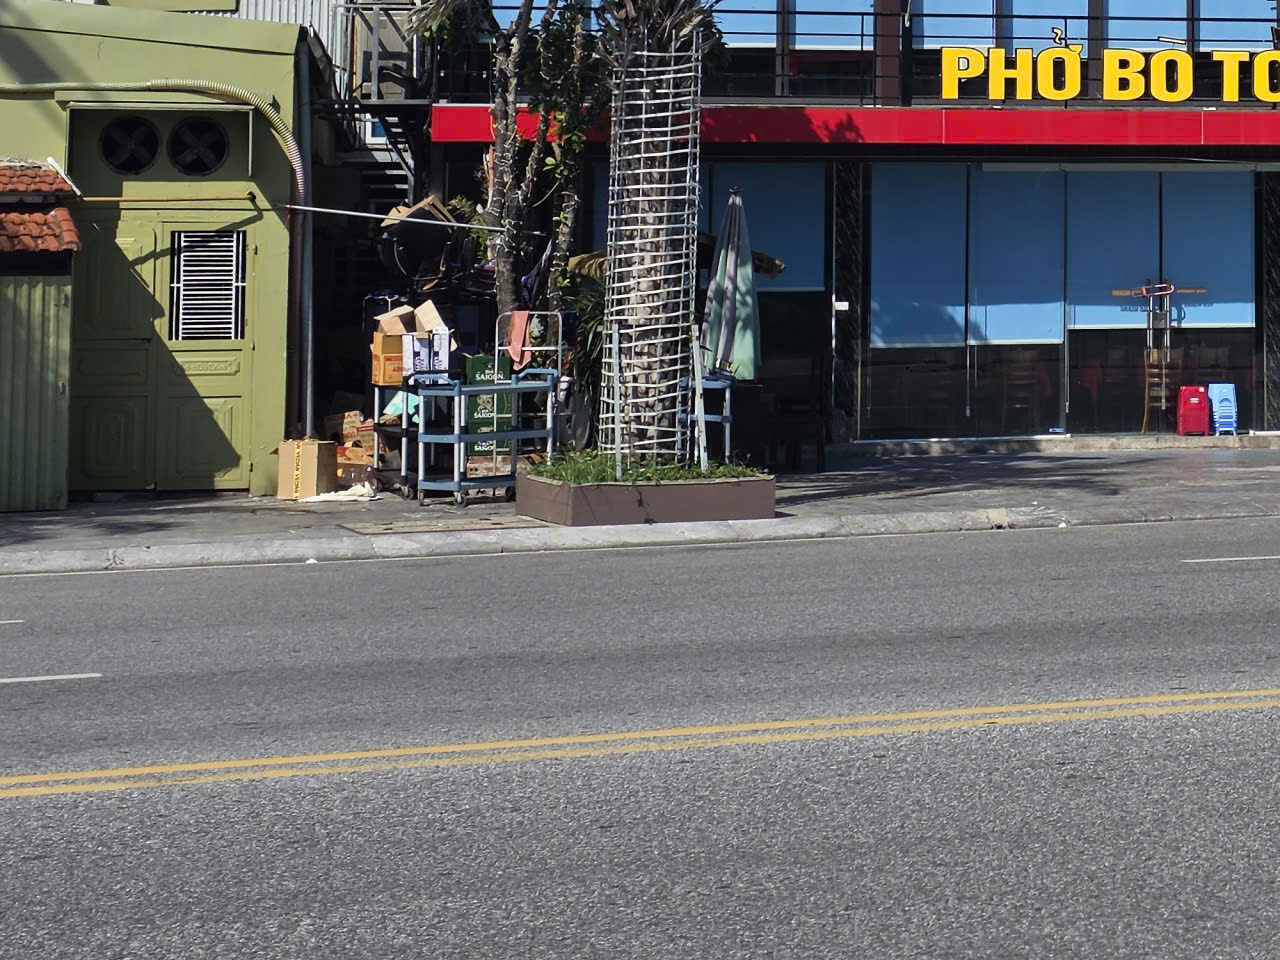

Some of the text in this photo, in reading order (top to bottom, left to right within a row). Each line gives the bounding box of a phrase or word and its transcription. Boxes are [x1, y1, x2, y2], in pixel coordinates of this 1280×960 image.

[941, 26, 1083, 101] PHỞ
[1103, 35, 1194, 103] BÒ
[475, 373, 505, 381] SAIGON
[473, 411, 496, 419] SAIGO
